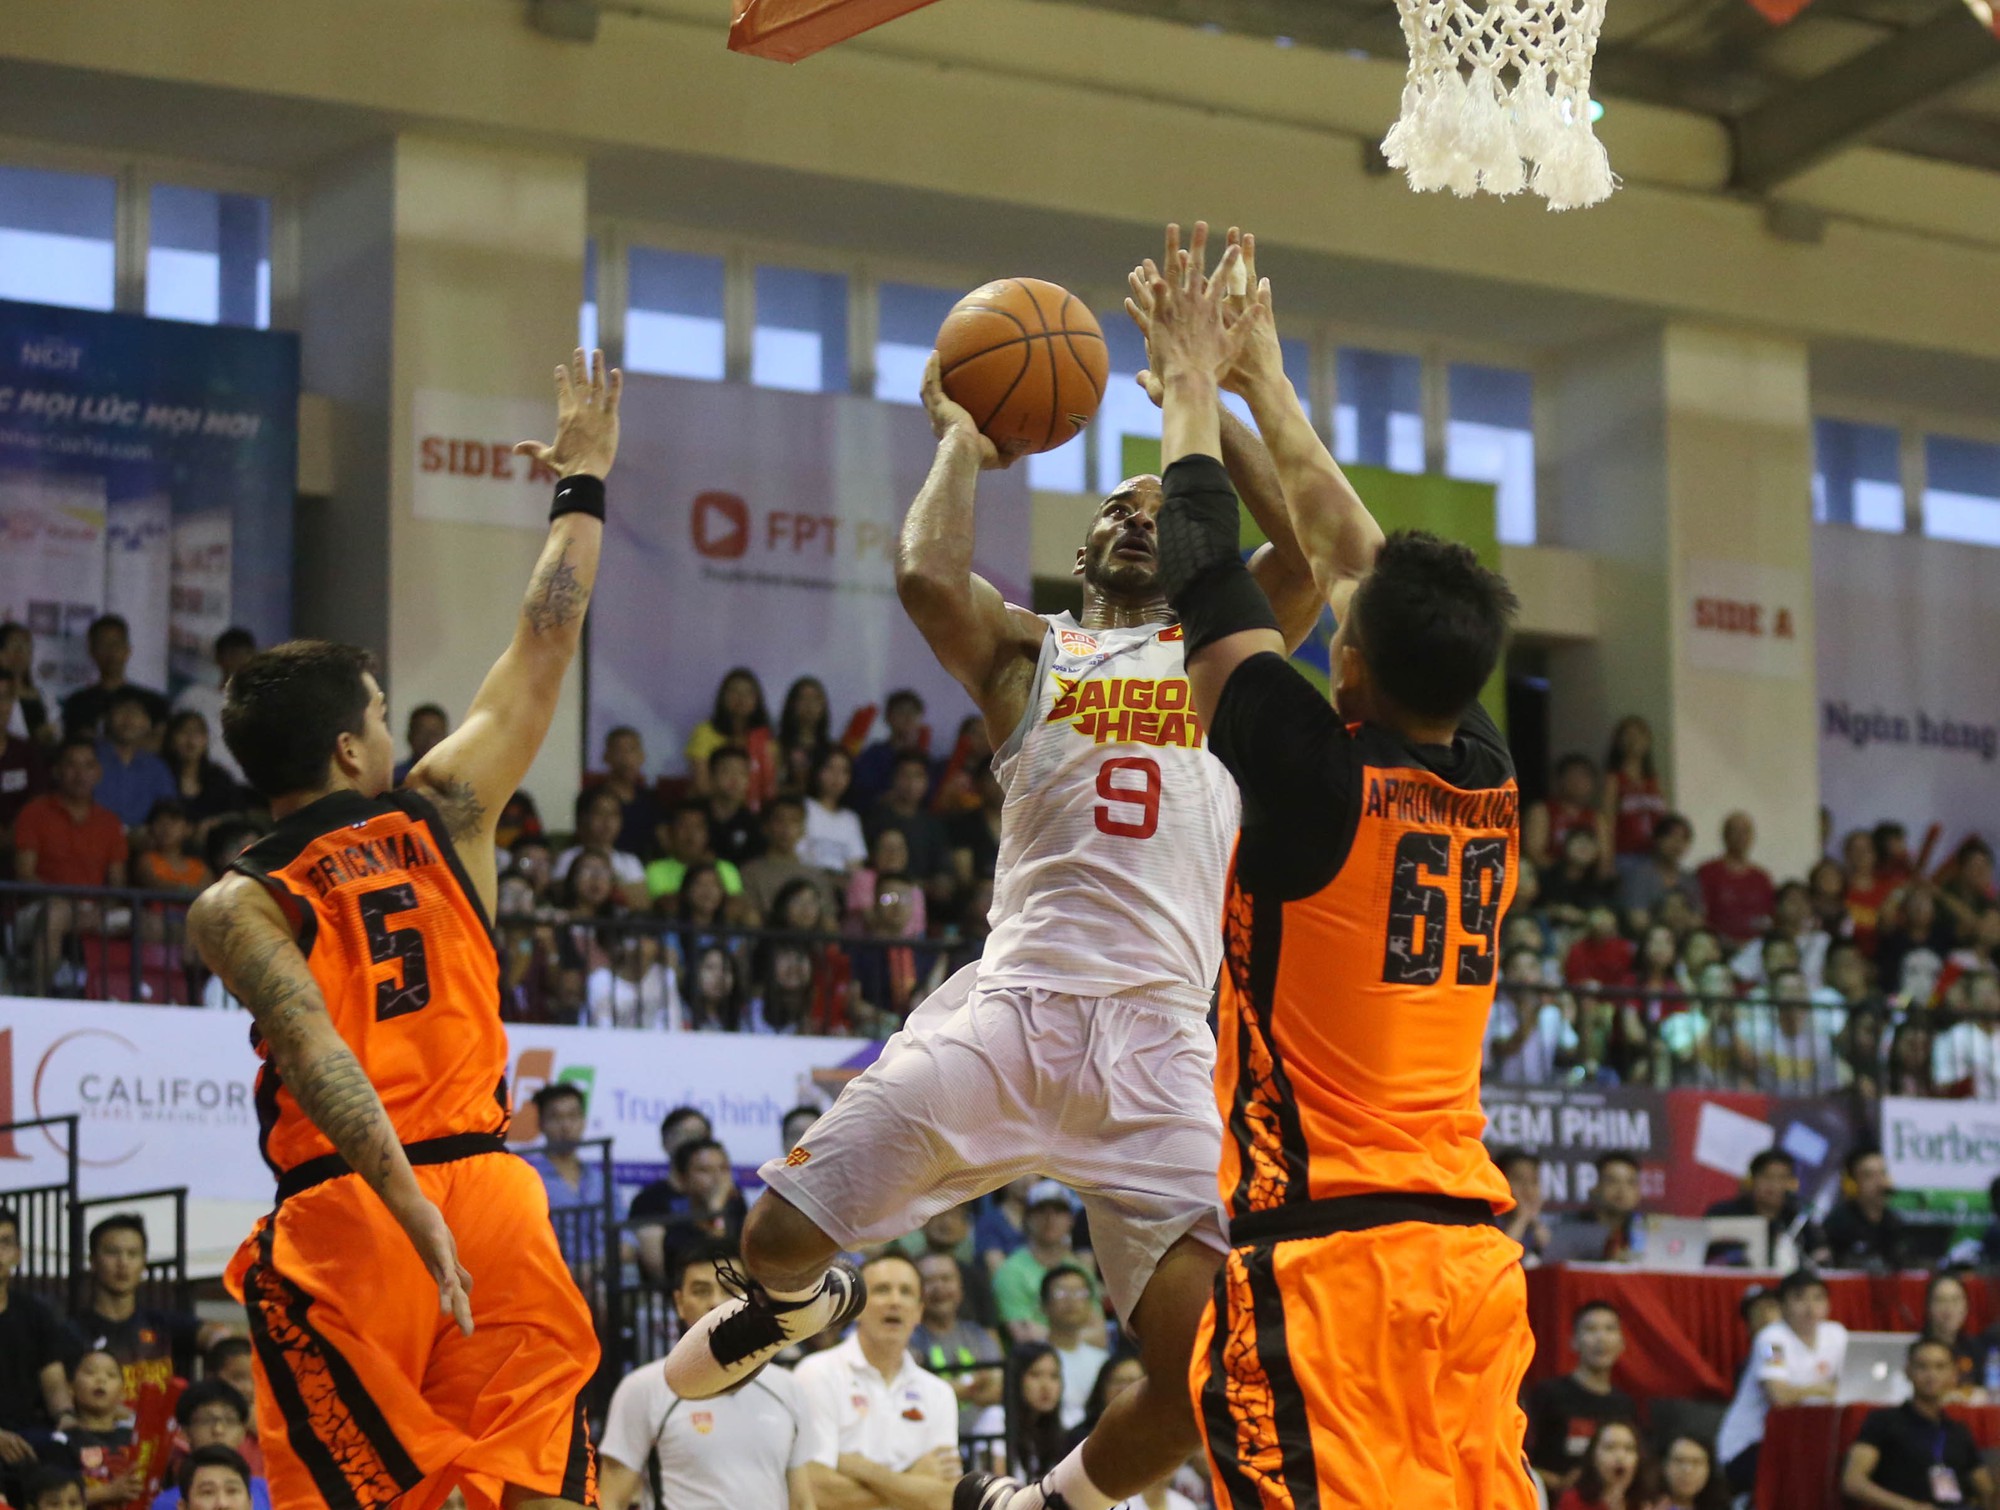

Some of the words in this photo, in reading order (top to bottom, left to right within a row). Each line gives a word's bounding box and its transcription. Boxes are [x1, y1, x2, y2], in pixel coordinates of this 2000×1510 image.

[421, 434, 514, 480] SIDE
[767, 511, 842, 558] FPT
[1062, 632, 1098, 648] ABL
[1074, 709, 1204, 749] HEAT
[1094, 756, 1162, 840] 9
[1381, 830, 1508, 987] 69
[358, 881, 431, 1024] 5
[79, 1074, 247, 1110] CALIFOR
[1560, 1105, 1651, 1150] PHIM
